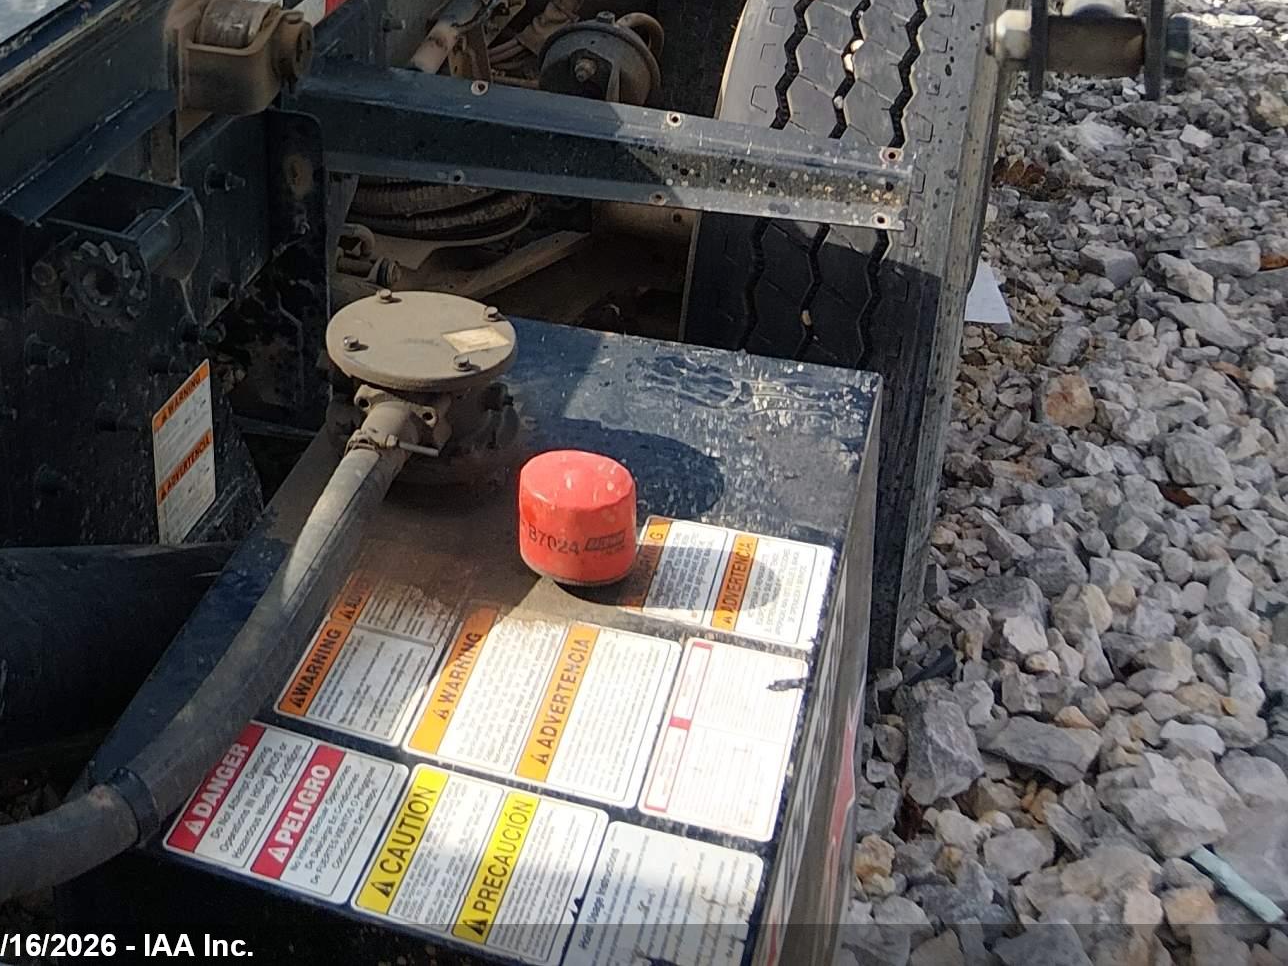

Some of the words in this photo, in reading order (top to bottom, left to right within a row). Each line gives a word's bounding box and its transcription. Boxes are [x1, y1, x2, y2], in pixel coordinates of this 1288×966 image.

[167, 374, 202, 415] WARNING
[528, 522, 580, 556] B7024
[715, 538, 755, 613] ADVERTENCIA
[290, 627, 343, 698] WARNING
[436, 631, 483, 705] WARNING
[534, 636, 591, 749] ADVERTENCIA
[190, 741, 250, 819] DANGER
[272, 762, 333, 845] PELIGRO
[376, 784, 438, 876] CAUTION
[471, 798, 534, 914] PRECAUCIÓN
